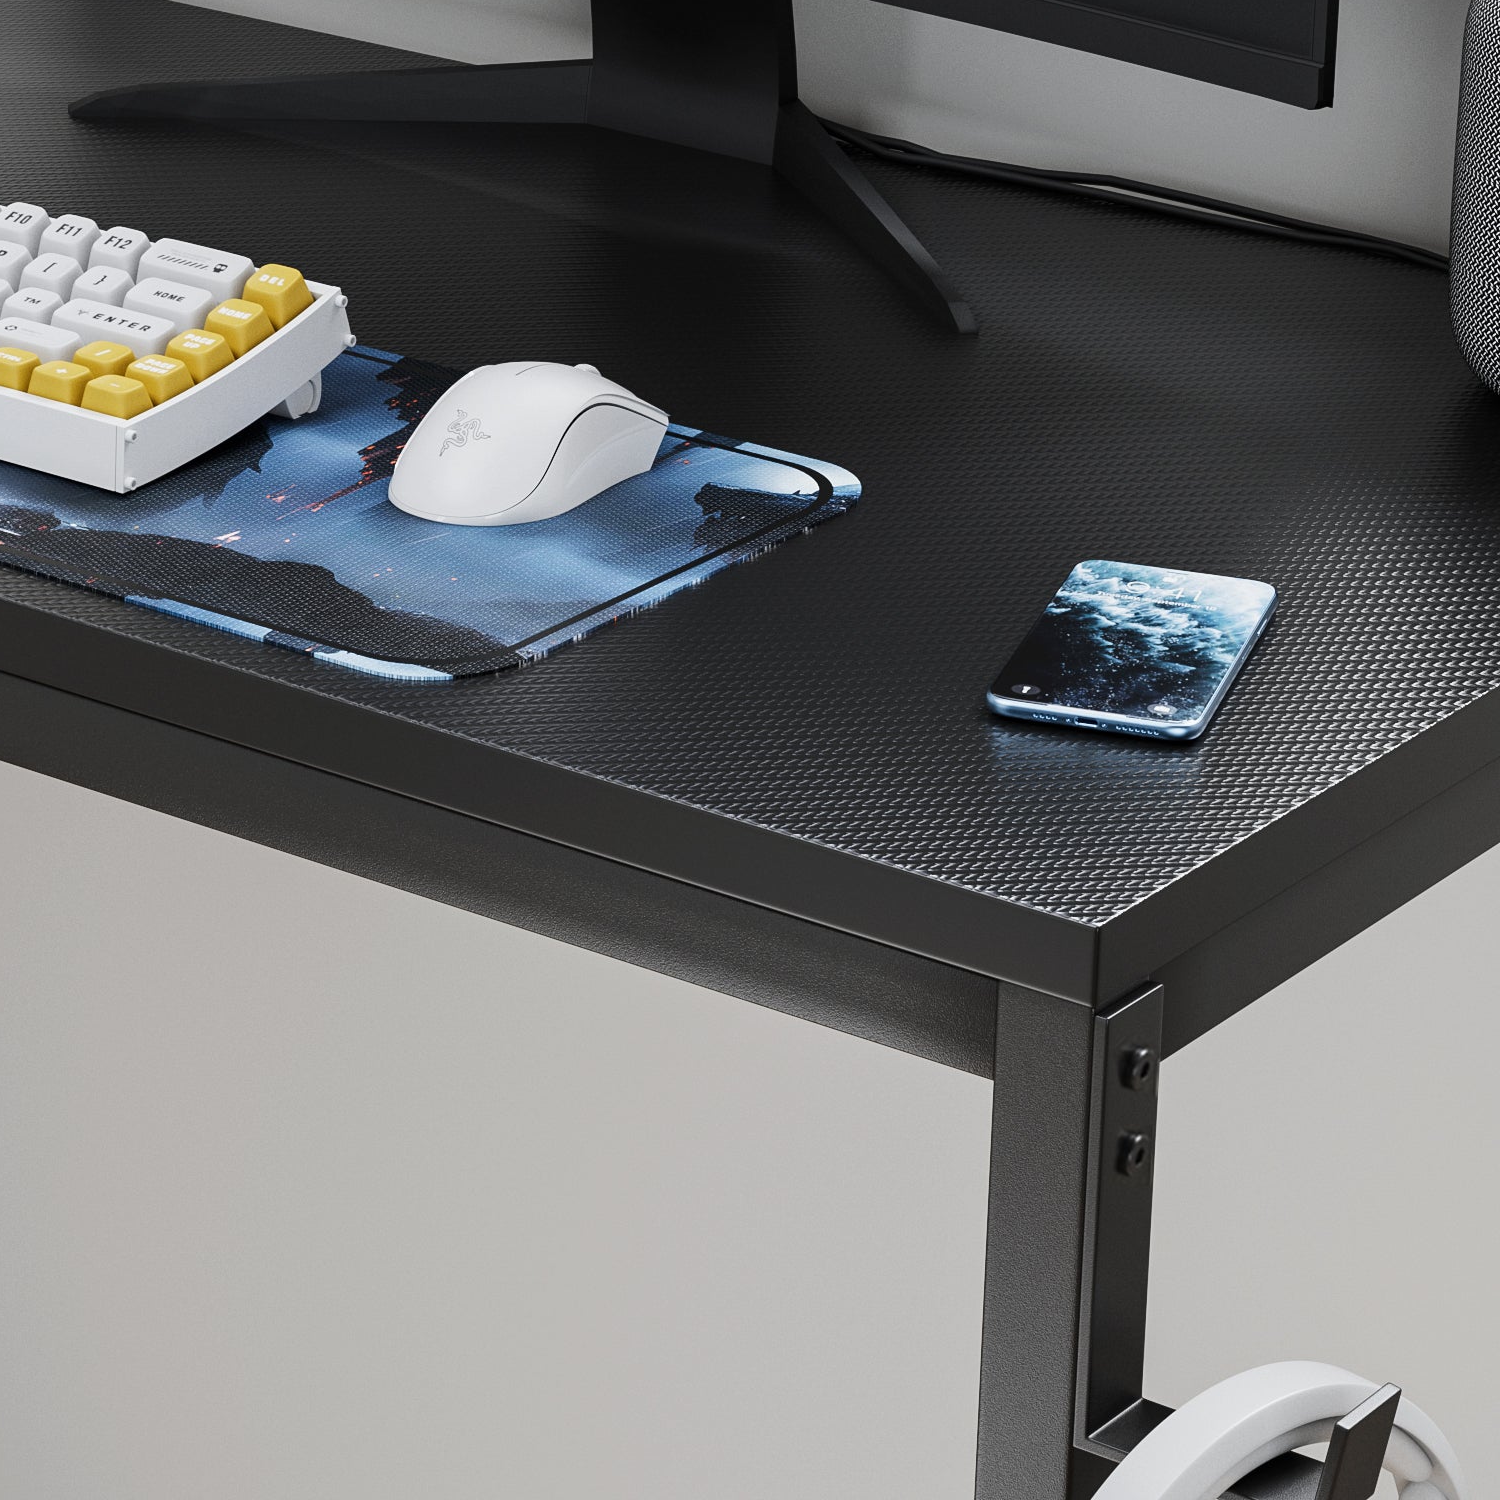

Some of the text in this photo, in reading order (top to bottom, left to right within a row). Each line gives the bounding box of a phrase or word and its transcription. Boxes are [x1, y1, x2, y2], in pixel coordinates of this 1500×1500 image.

[4, 211, 33, 225] F10
[55, 223, 83, 237] F11
[103, 235, 133, 250] F12
[259, 273, 285, 287] DEL
[153, 290, 185, 302] HOME
[92, 312, 152, 332] ENTER
